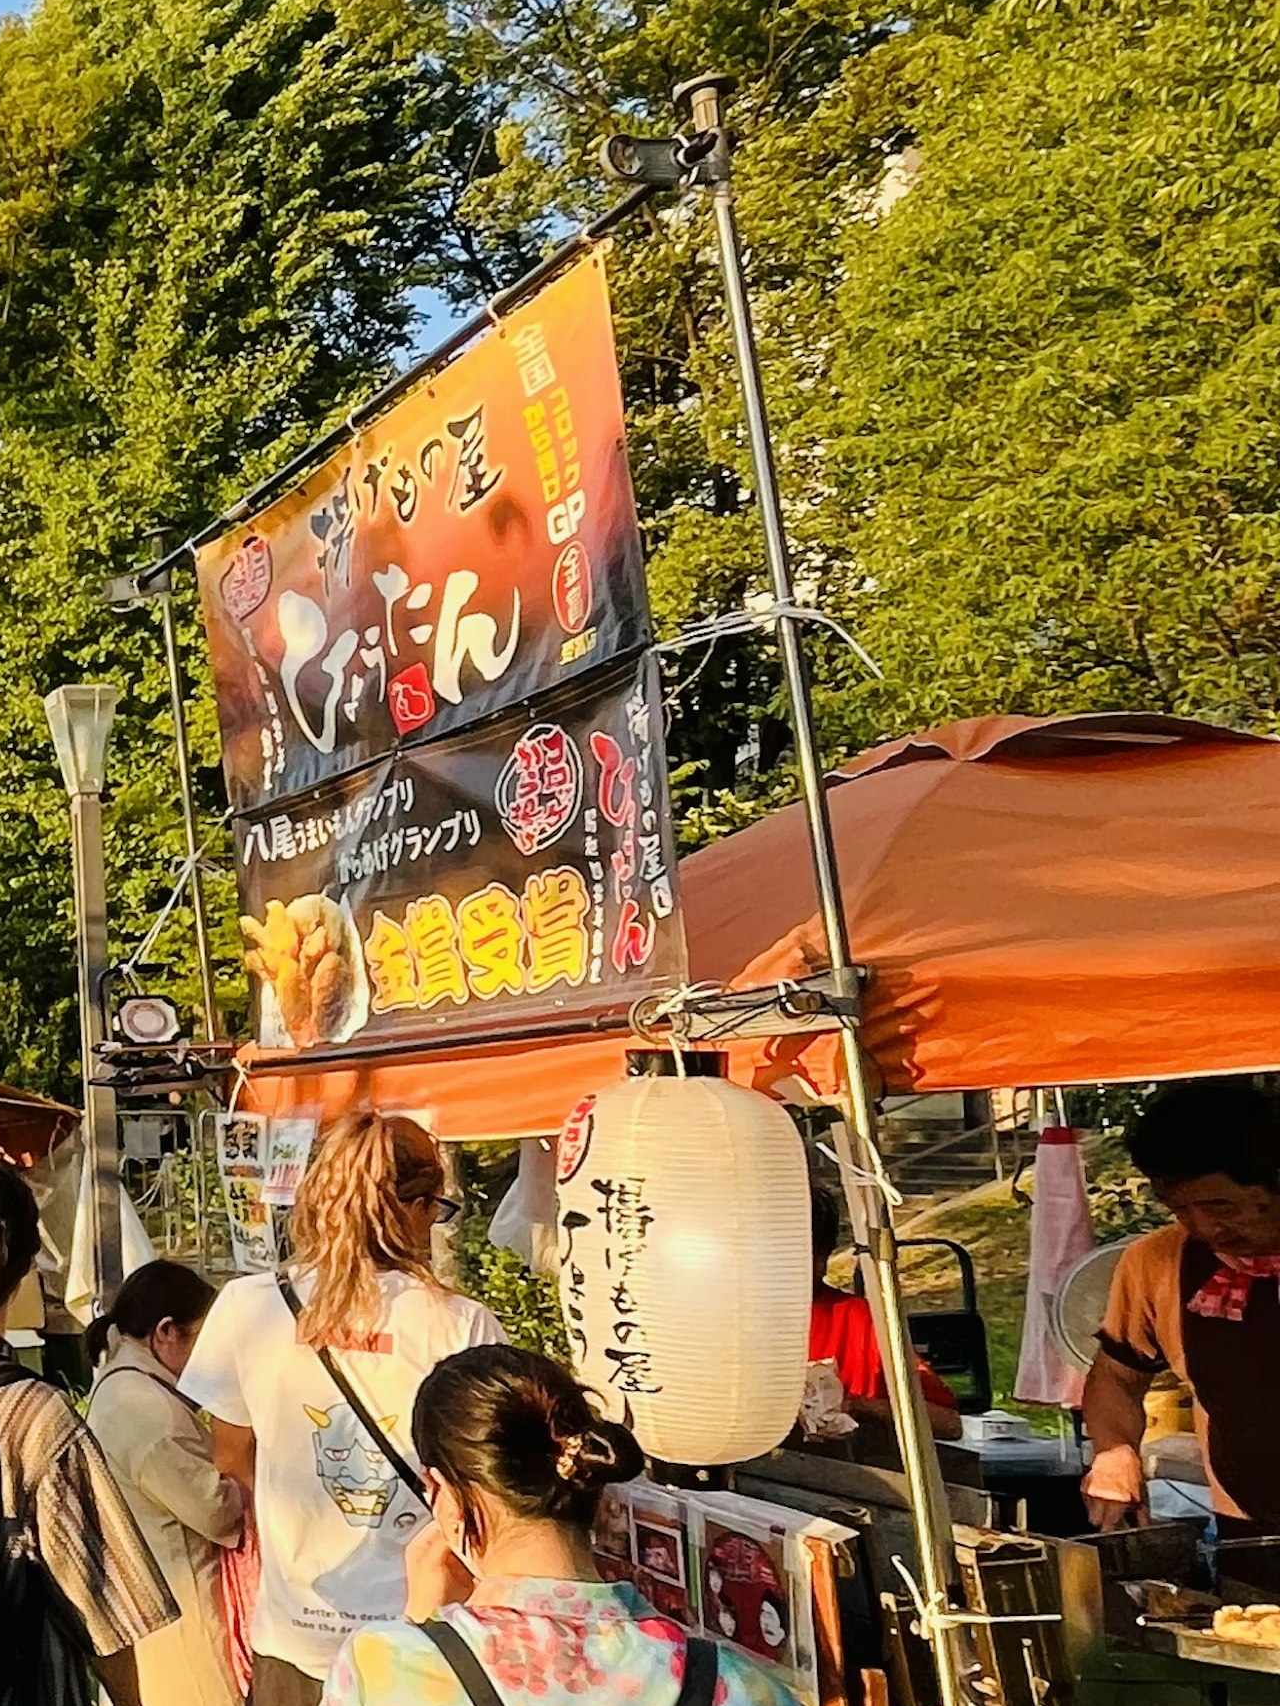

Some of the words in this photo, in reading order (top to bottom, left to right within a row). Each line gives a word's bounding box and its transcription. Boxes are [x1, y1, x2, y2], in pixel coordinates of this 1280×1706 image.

[509, 323, 556, 398] 全国
[546, 489, 587, 546] GP
[276, 563, 521, 754] ひょうたん
[365, 865, 591, 1016] 金賞受賞
